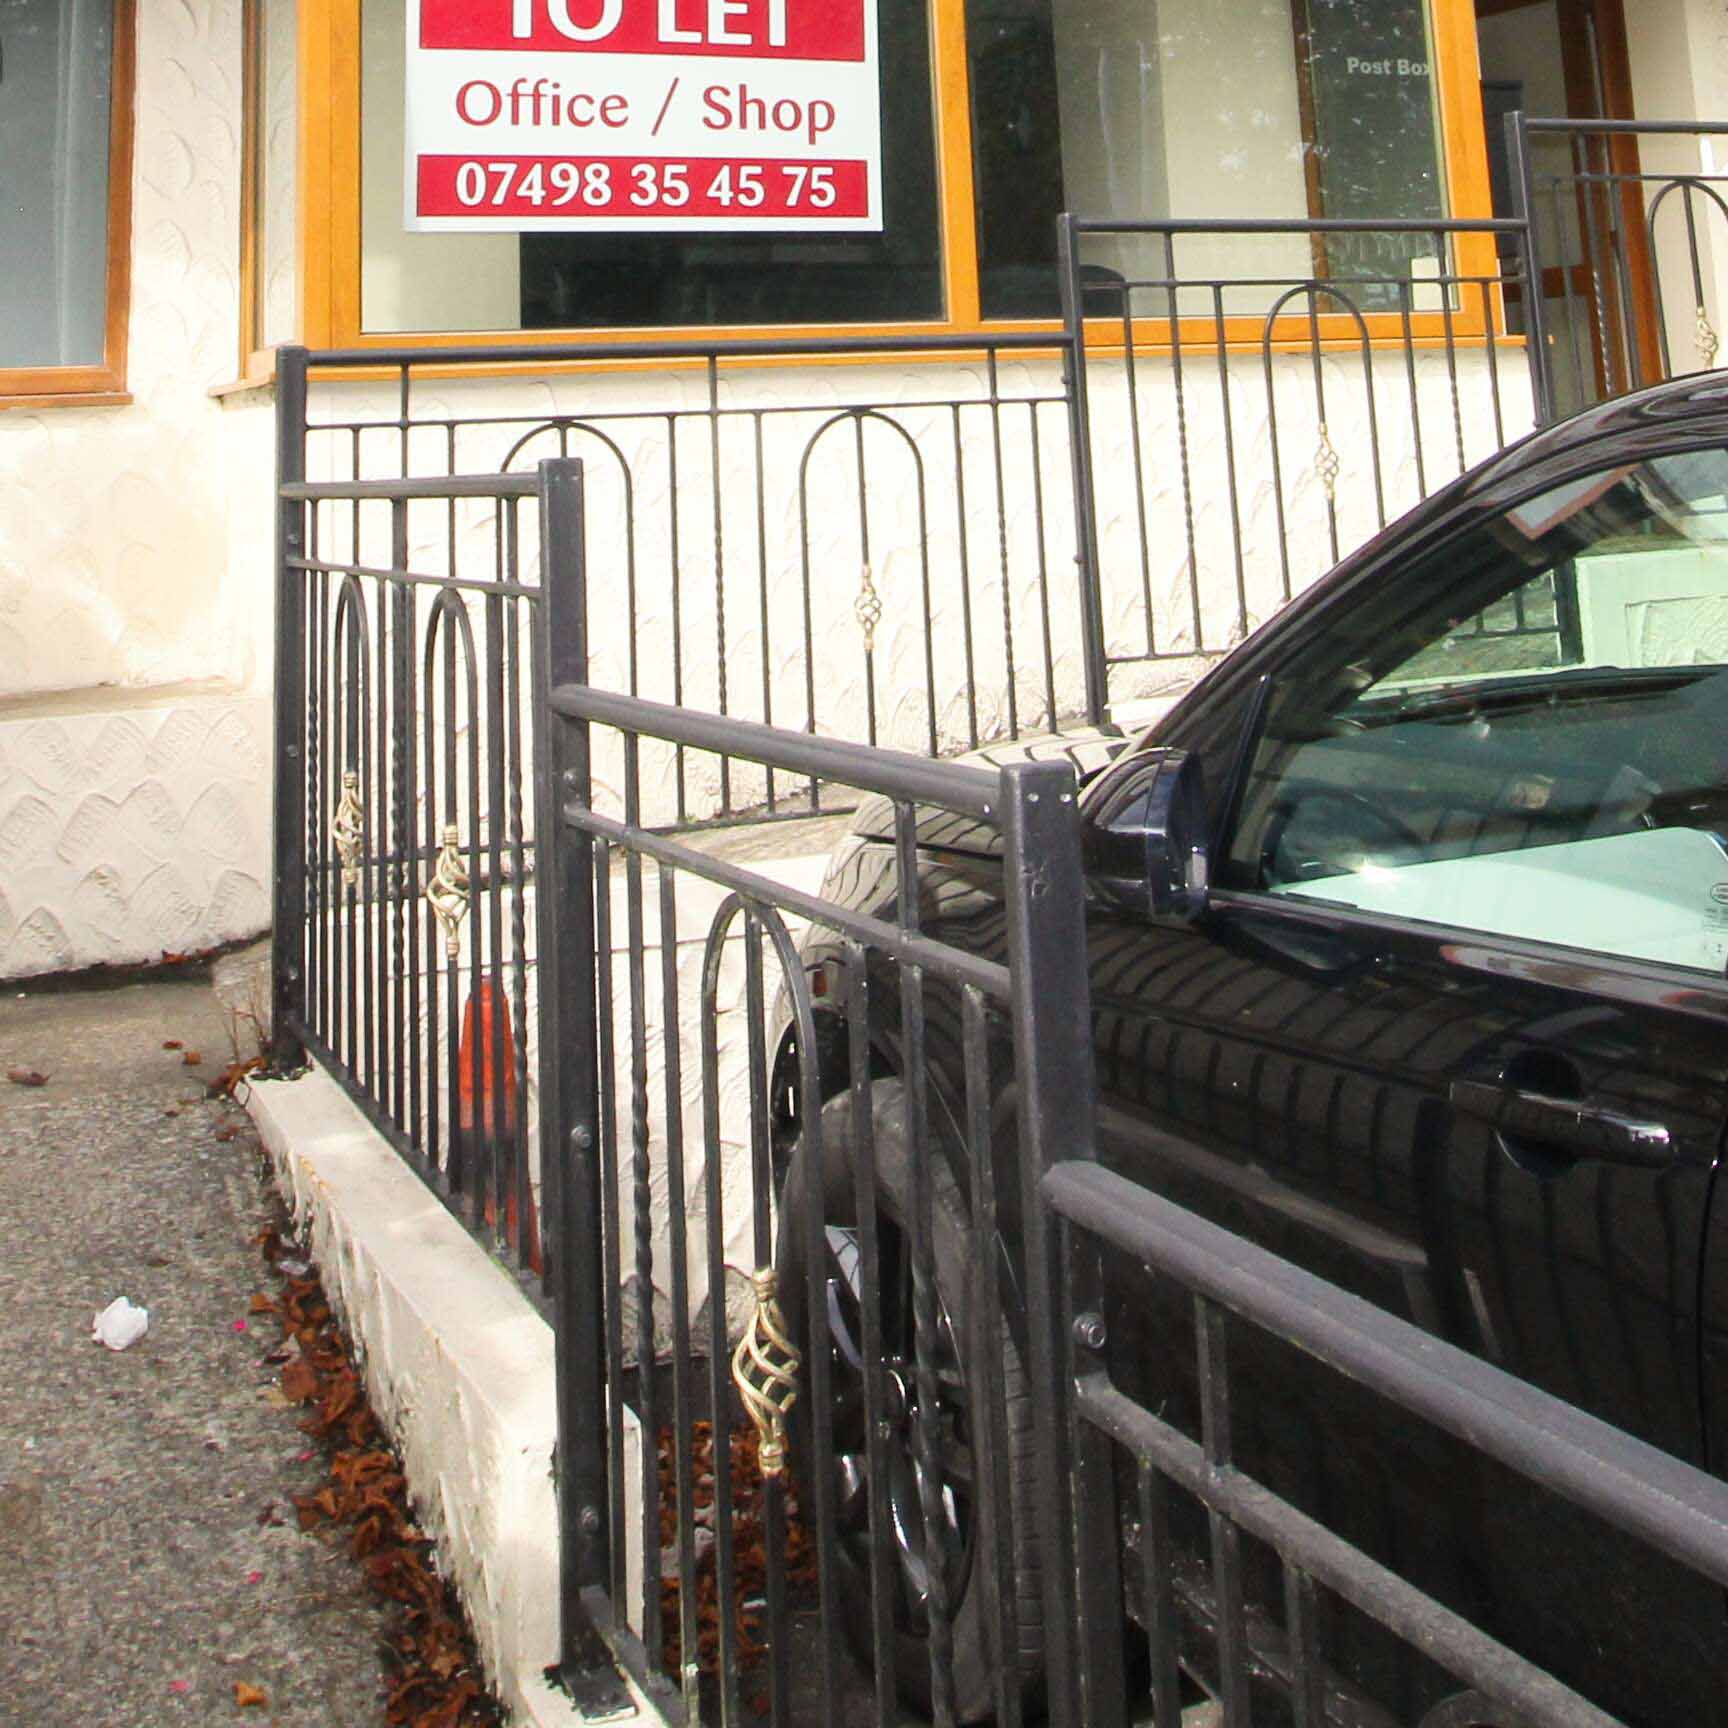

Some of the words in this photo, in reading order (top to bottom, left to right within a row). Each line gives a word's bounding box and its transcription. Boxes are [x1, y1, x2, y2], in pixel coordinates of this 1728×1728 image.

[1346, 56, 1392, 75] Post
[455, 77, 630, 130] Office
[651, 76, 680, 136] /
[702, 82, 836, 146] Shop
[455, 162, 613, 207] 07498
[629, 163, 690, 207] 35
[706, 164, 766, 208] 45
[782, 166, 836, 208] 75
